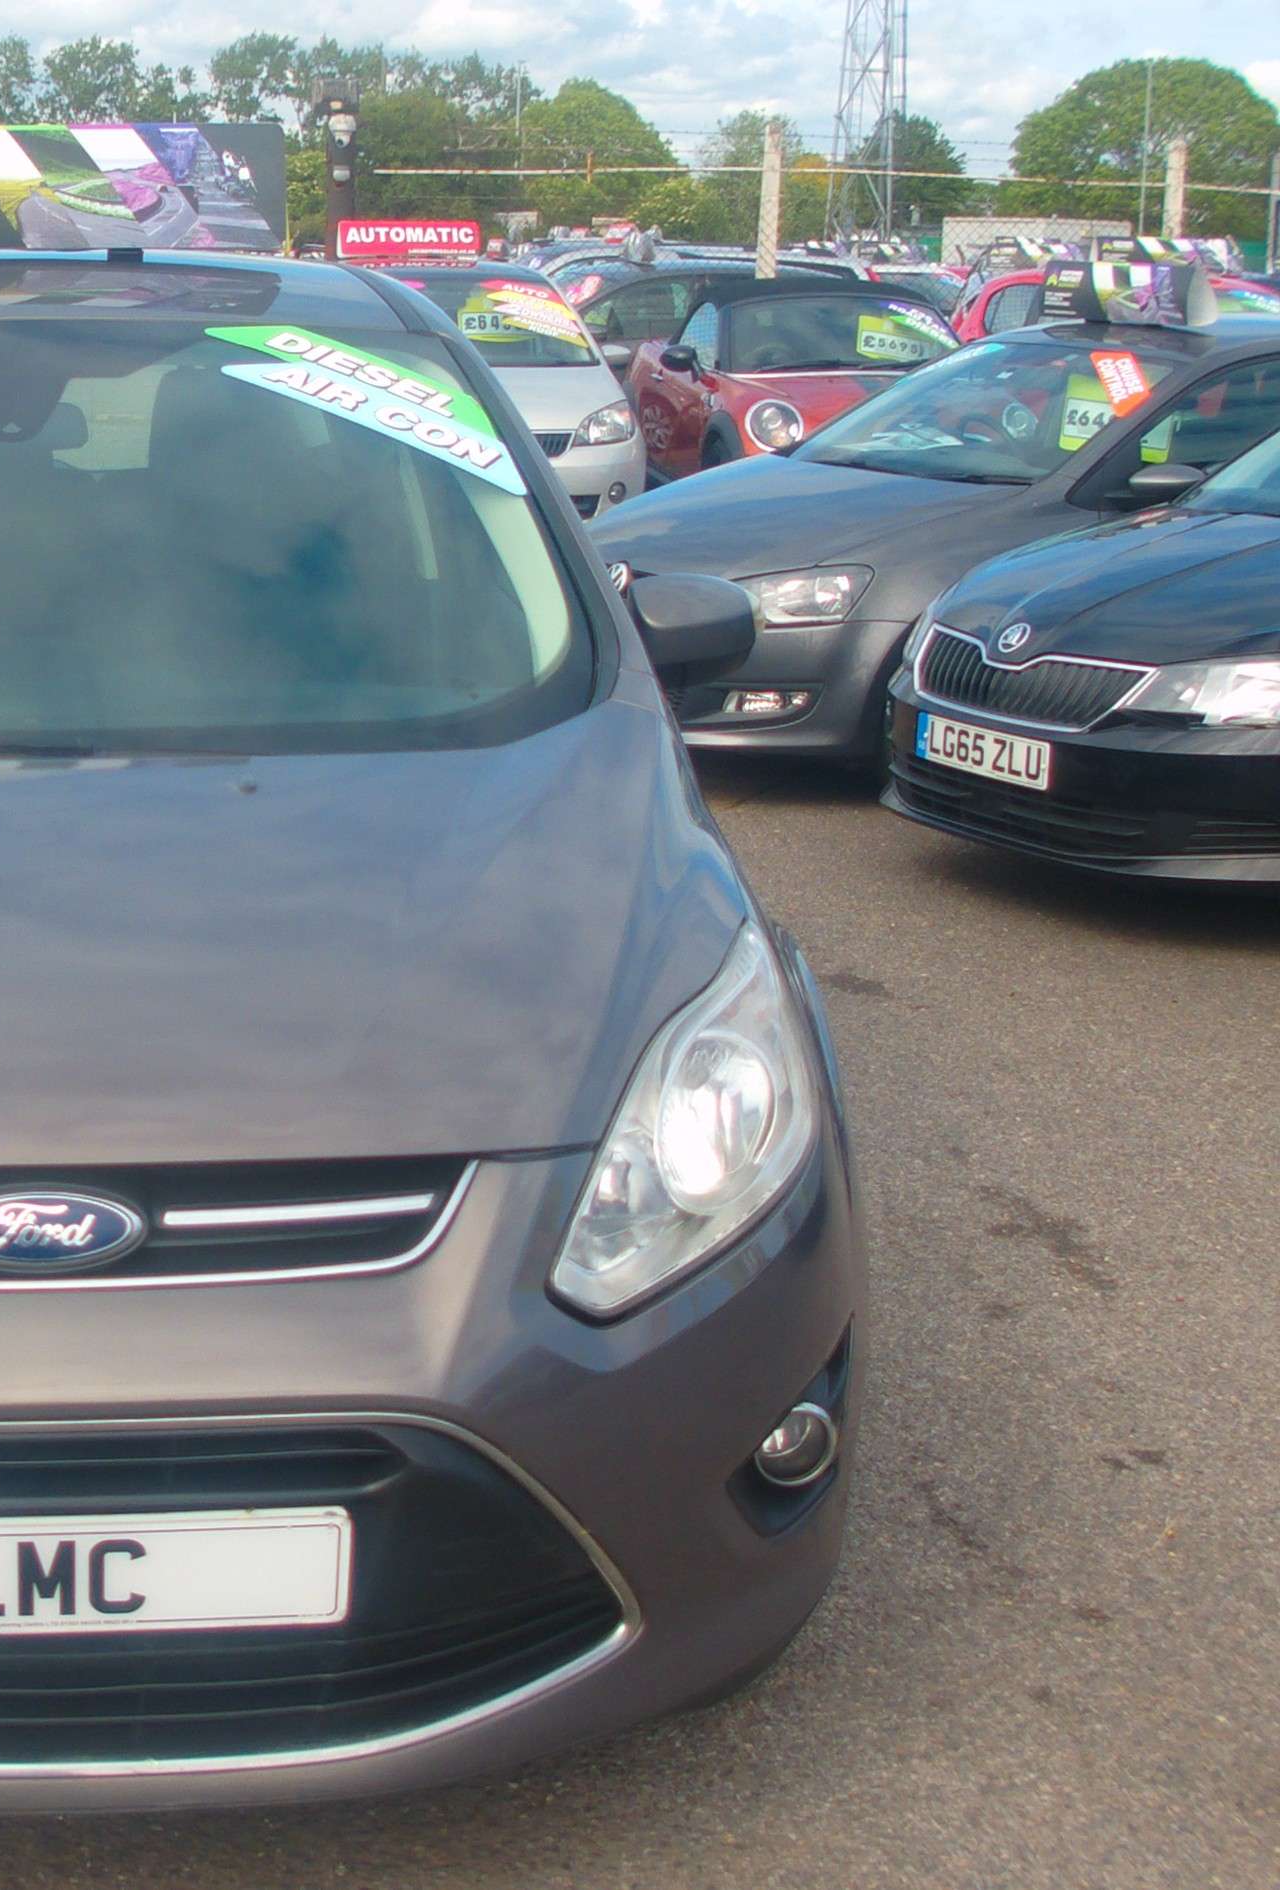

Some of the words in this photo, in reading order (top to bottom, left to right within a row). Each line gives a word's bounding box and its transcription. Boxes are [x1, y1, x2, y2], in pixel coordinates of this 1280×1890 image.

[345, 226, 475, 244] AUTOMATIC
[501, 283, 549, 299] AUTO
[264, 331, 455, 420] DIESEL
[1097, 357, 1129, 405] CONTROL
[1115, 357, 1145, 395] CRUISE
[260, 366, 369, 412] AIR
[373, 404, 503, 469] CON
[1066, 408, 1114, 429] £64
[929, 720, 986, 767] LG65
[991, 737, 1042, 781] ZLU
